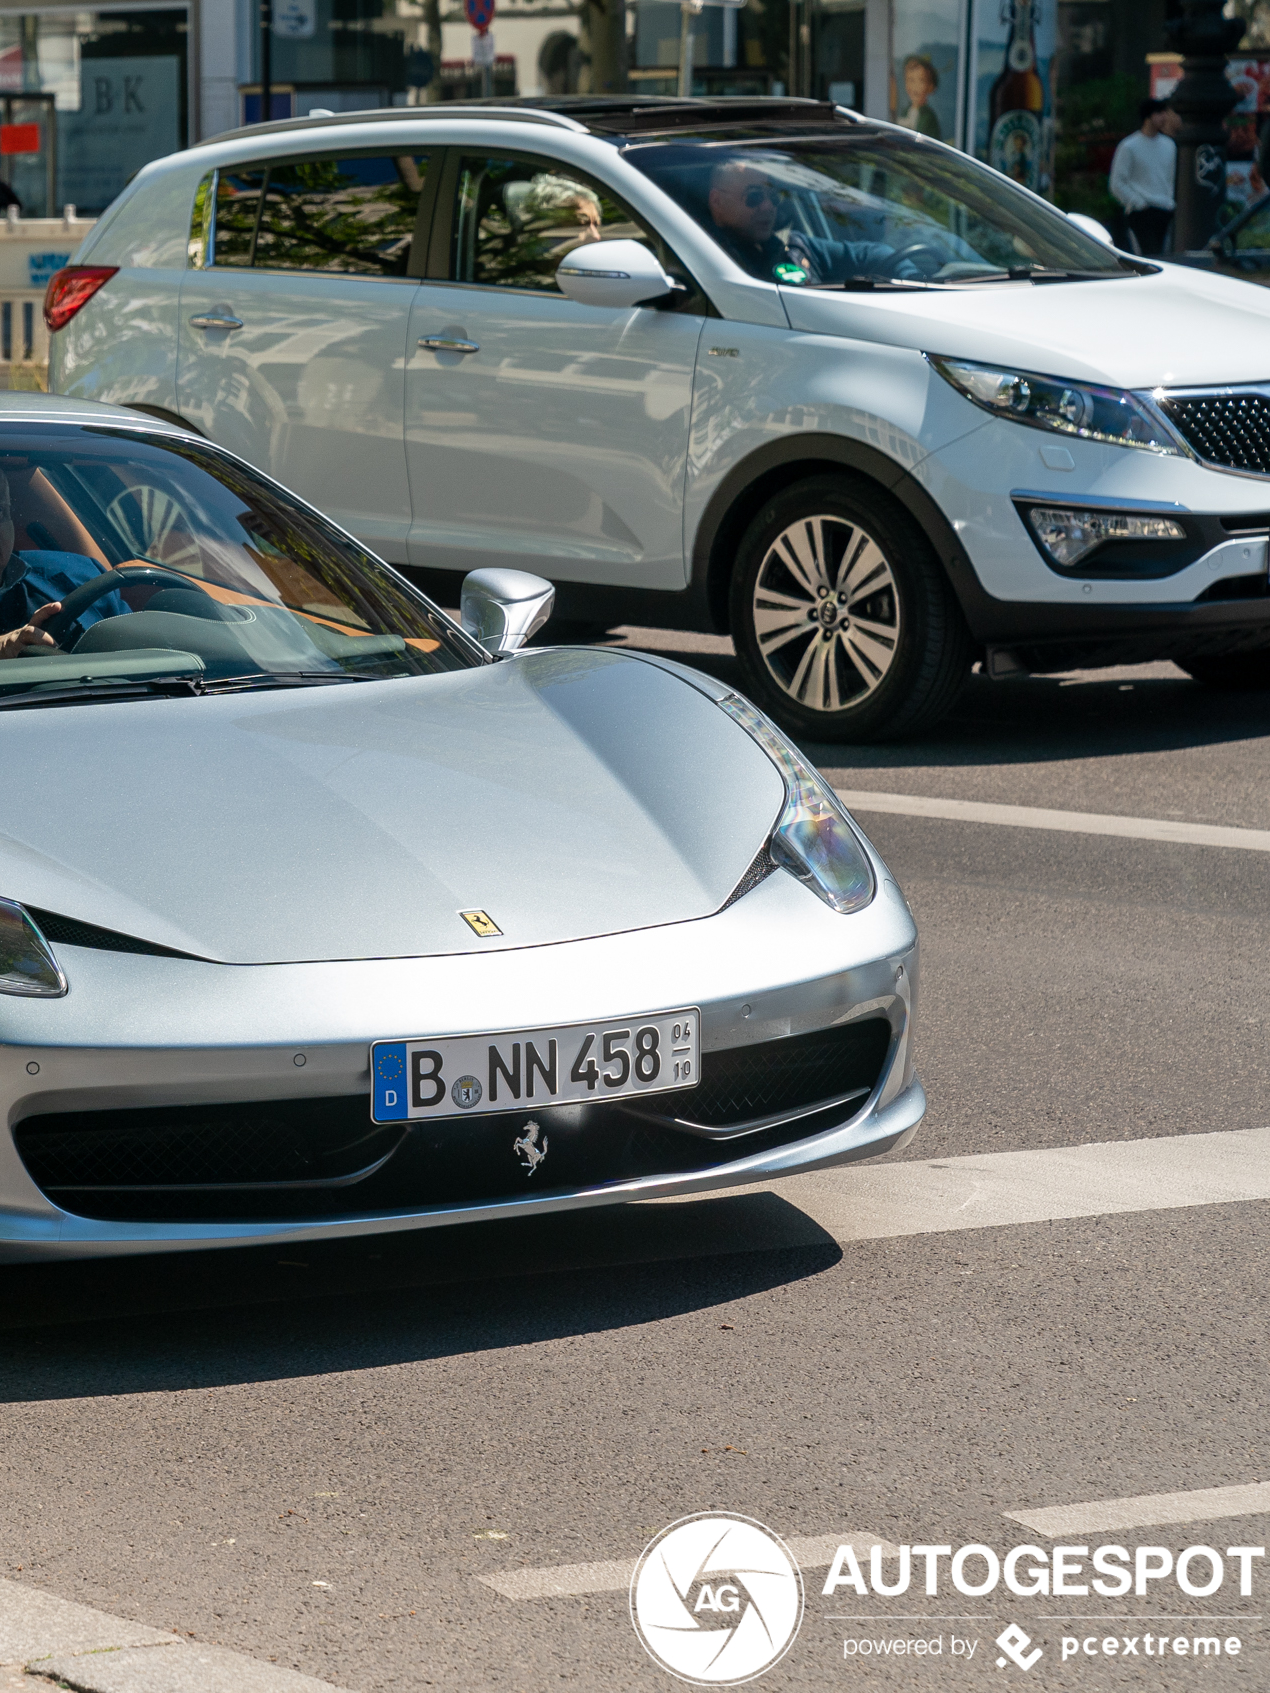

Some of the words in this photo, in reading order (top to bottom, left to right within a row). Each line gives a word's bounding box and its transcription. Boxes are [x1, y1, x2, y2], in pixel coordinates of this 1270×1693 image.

[671, 1020, 691, 1040] 04
[411, 1049, 447, 1108] B
[488, 1037, 558, 1102] NN
[570, 1025, 661, 1091] 458
[673, 1060, 691, 1081] 10
[384, 1089, 398, 1107] D
